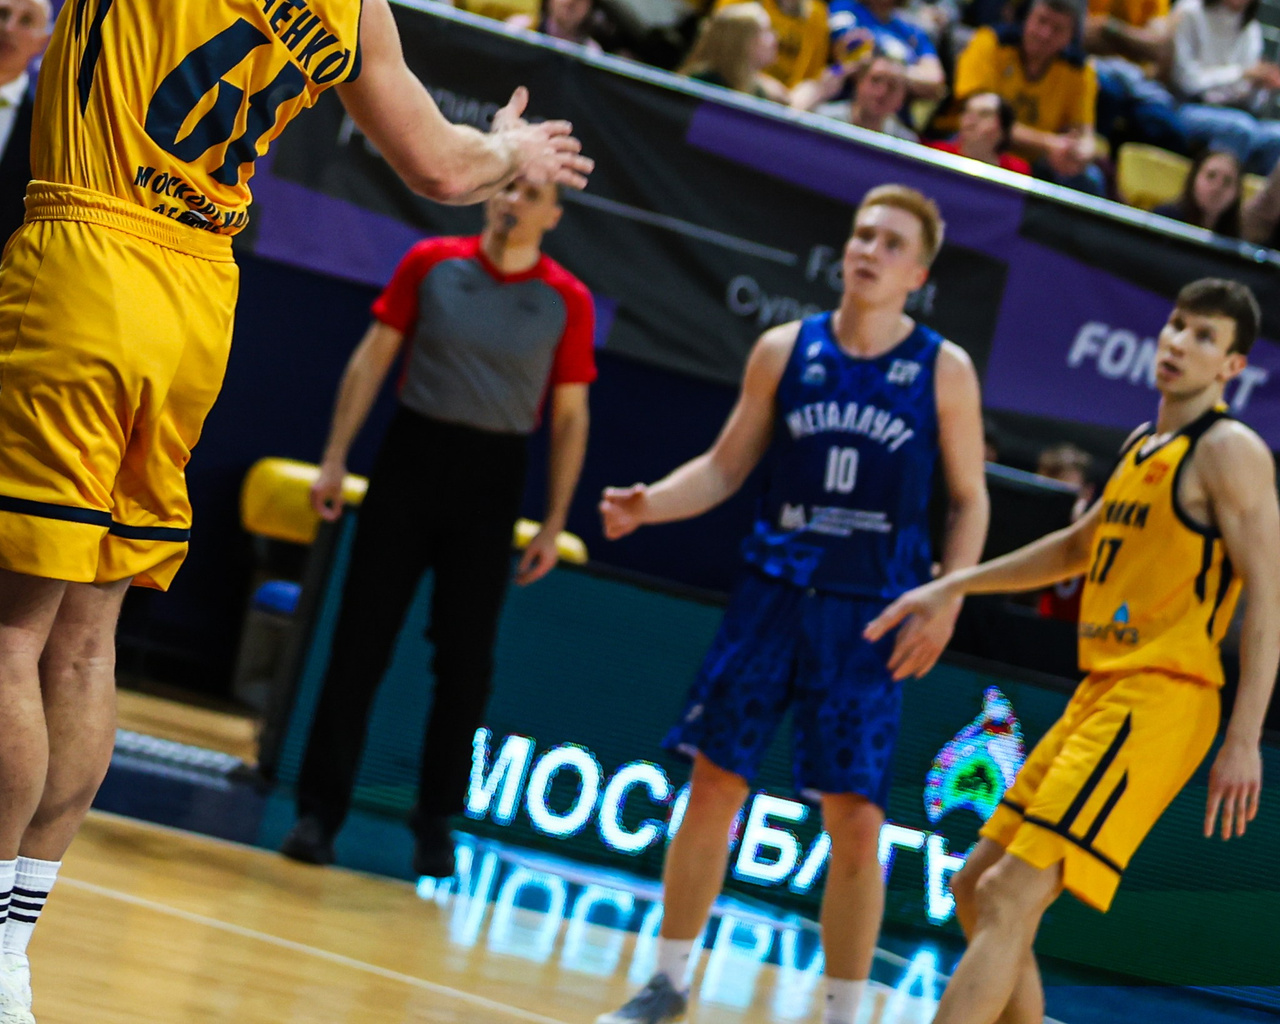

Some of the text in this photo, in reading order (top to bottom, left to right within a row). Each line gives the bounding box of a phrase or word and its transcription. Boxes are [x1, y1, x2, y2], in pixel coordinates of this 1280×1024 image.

[1068, 321, 1270, 413] FONT
[787, 401, 914, 453] МЕТАЛЛУРГ
[825, 445, 859, 494] 10
